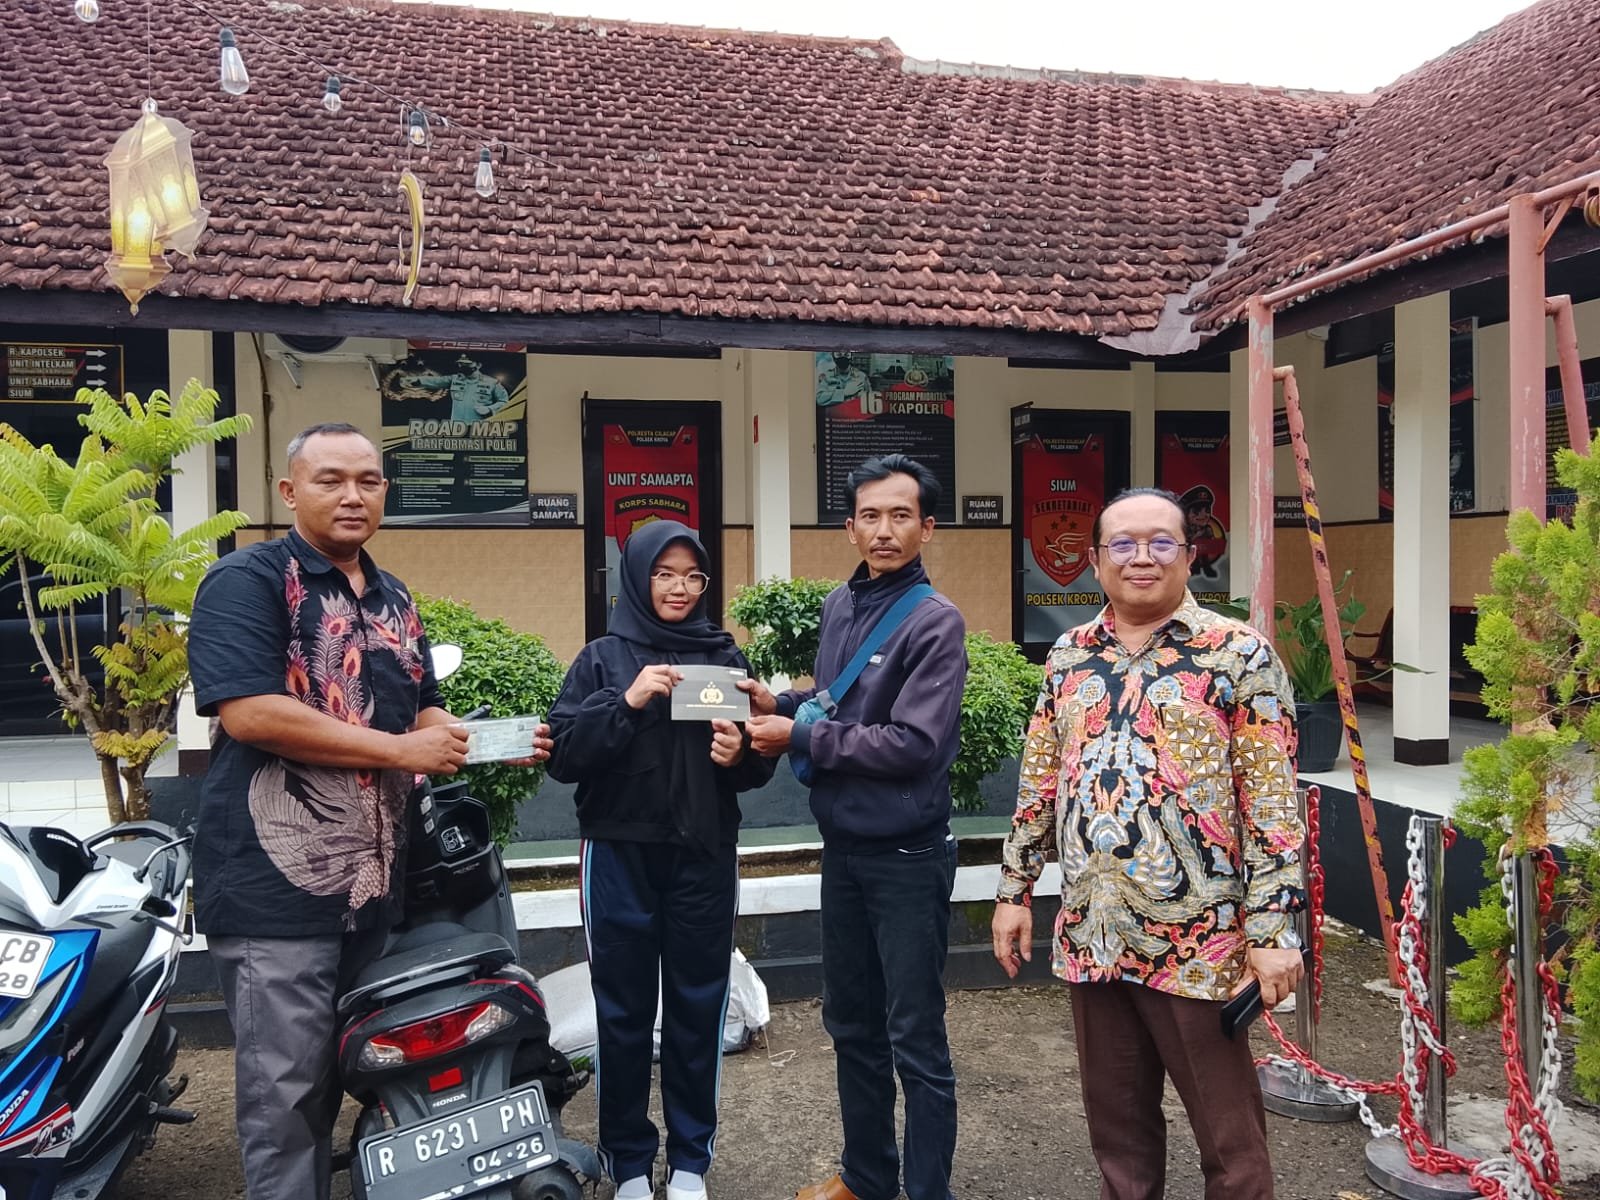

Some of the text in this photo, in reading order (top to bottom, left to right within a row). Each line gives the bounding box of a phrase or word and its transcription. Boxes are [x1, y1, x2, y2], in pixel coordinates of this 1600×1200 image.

[20, 347, 65, 357] KAPOLSEK
[10, 360, 74, 368] UNIT INTELKAM
[10, 377, 72, 386] UNIT SABHARA
[10, 389, 32, 397] SIUM
[859, 391, 883, 414] 16
[885, 391, 915, 401] PROGRAM
[889, 403, 944, 414] KAPOLRI
[409, 420, 517, 438] ROAD MAP
[487, 439, 517, 451] POLRI
[608, 473, 694, 486] UNIT SAMAPTA
[1050, 480, 1076, 491] SIUM
[537, 498, 569, 507] RUANG
[619, 499, 686, 511] KORPS SABHARA
[532, 511, 575, 519] SAMAPTA
[1027, 593, 1101, 605] POLSEK KROYA
[432, 1093, 467, 1108] HONDA
[378, 1147, 395, 1176] R
[415, 1117, 479, 1162] 6231
